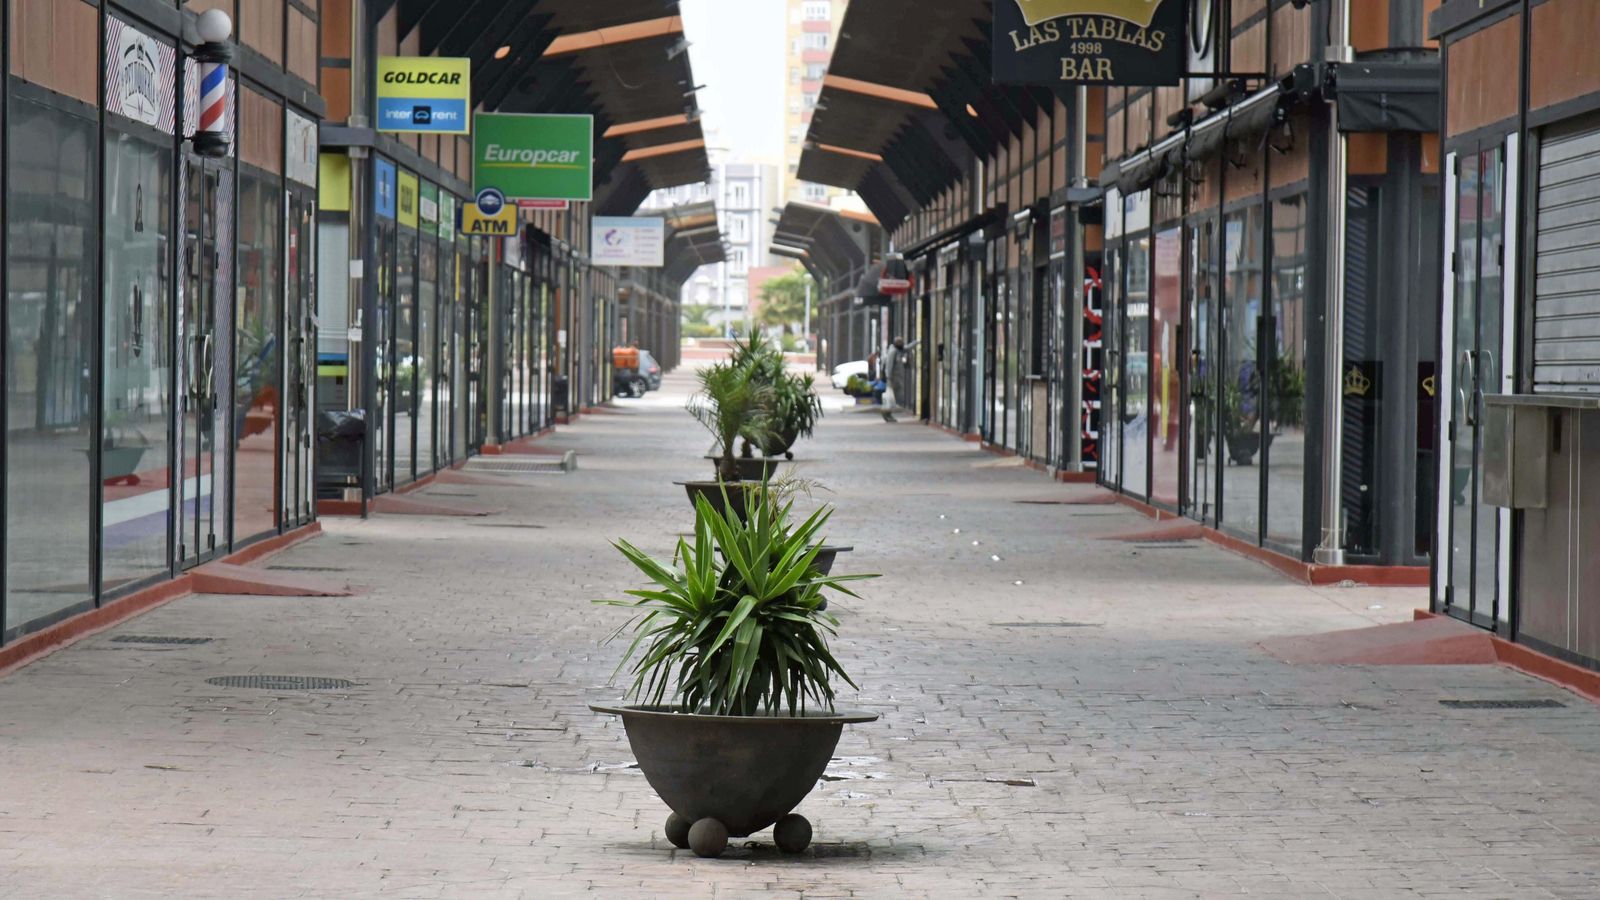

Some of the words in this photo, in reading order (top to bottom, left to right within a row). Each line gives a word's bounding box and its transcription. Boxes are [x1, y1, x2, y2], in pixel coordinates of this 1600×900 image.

[1008, 20, 1061, 52] LAS
[1066, 17, 1166, 52] TABLAS
[1070, 42, 1102, 55] 1998
[1060, 57, 1114, 80] BAR
[384, 71, 461, 85] GOLDCAR
[385, 109, 412, 120] inter
[431, 110, 458, 120] rent
[484, 143, 580, 167] Europcar
[471, 219, 508, 233] ATM
